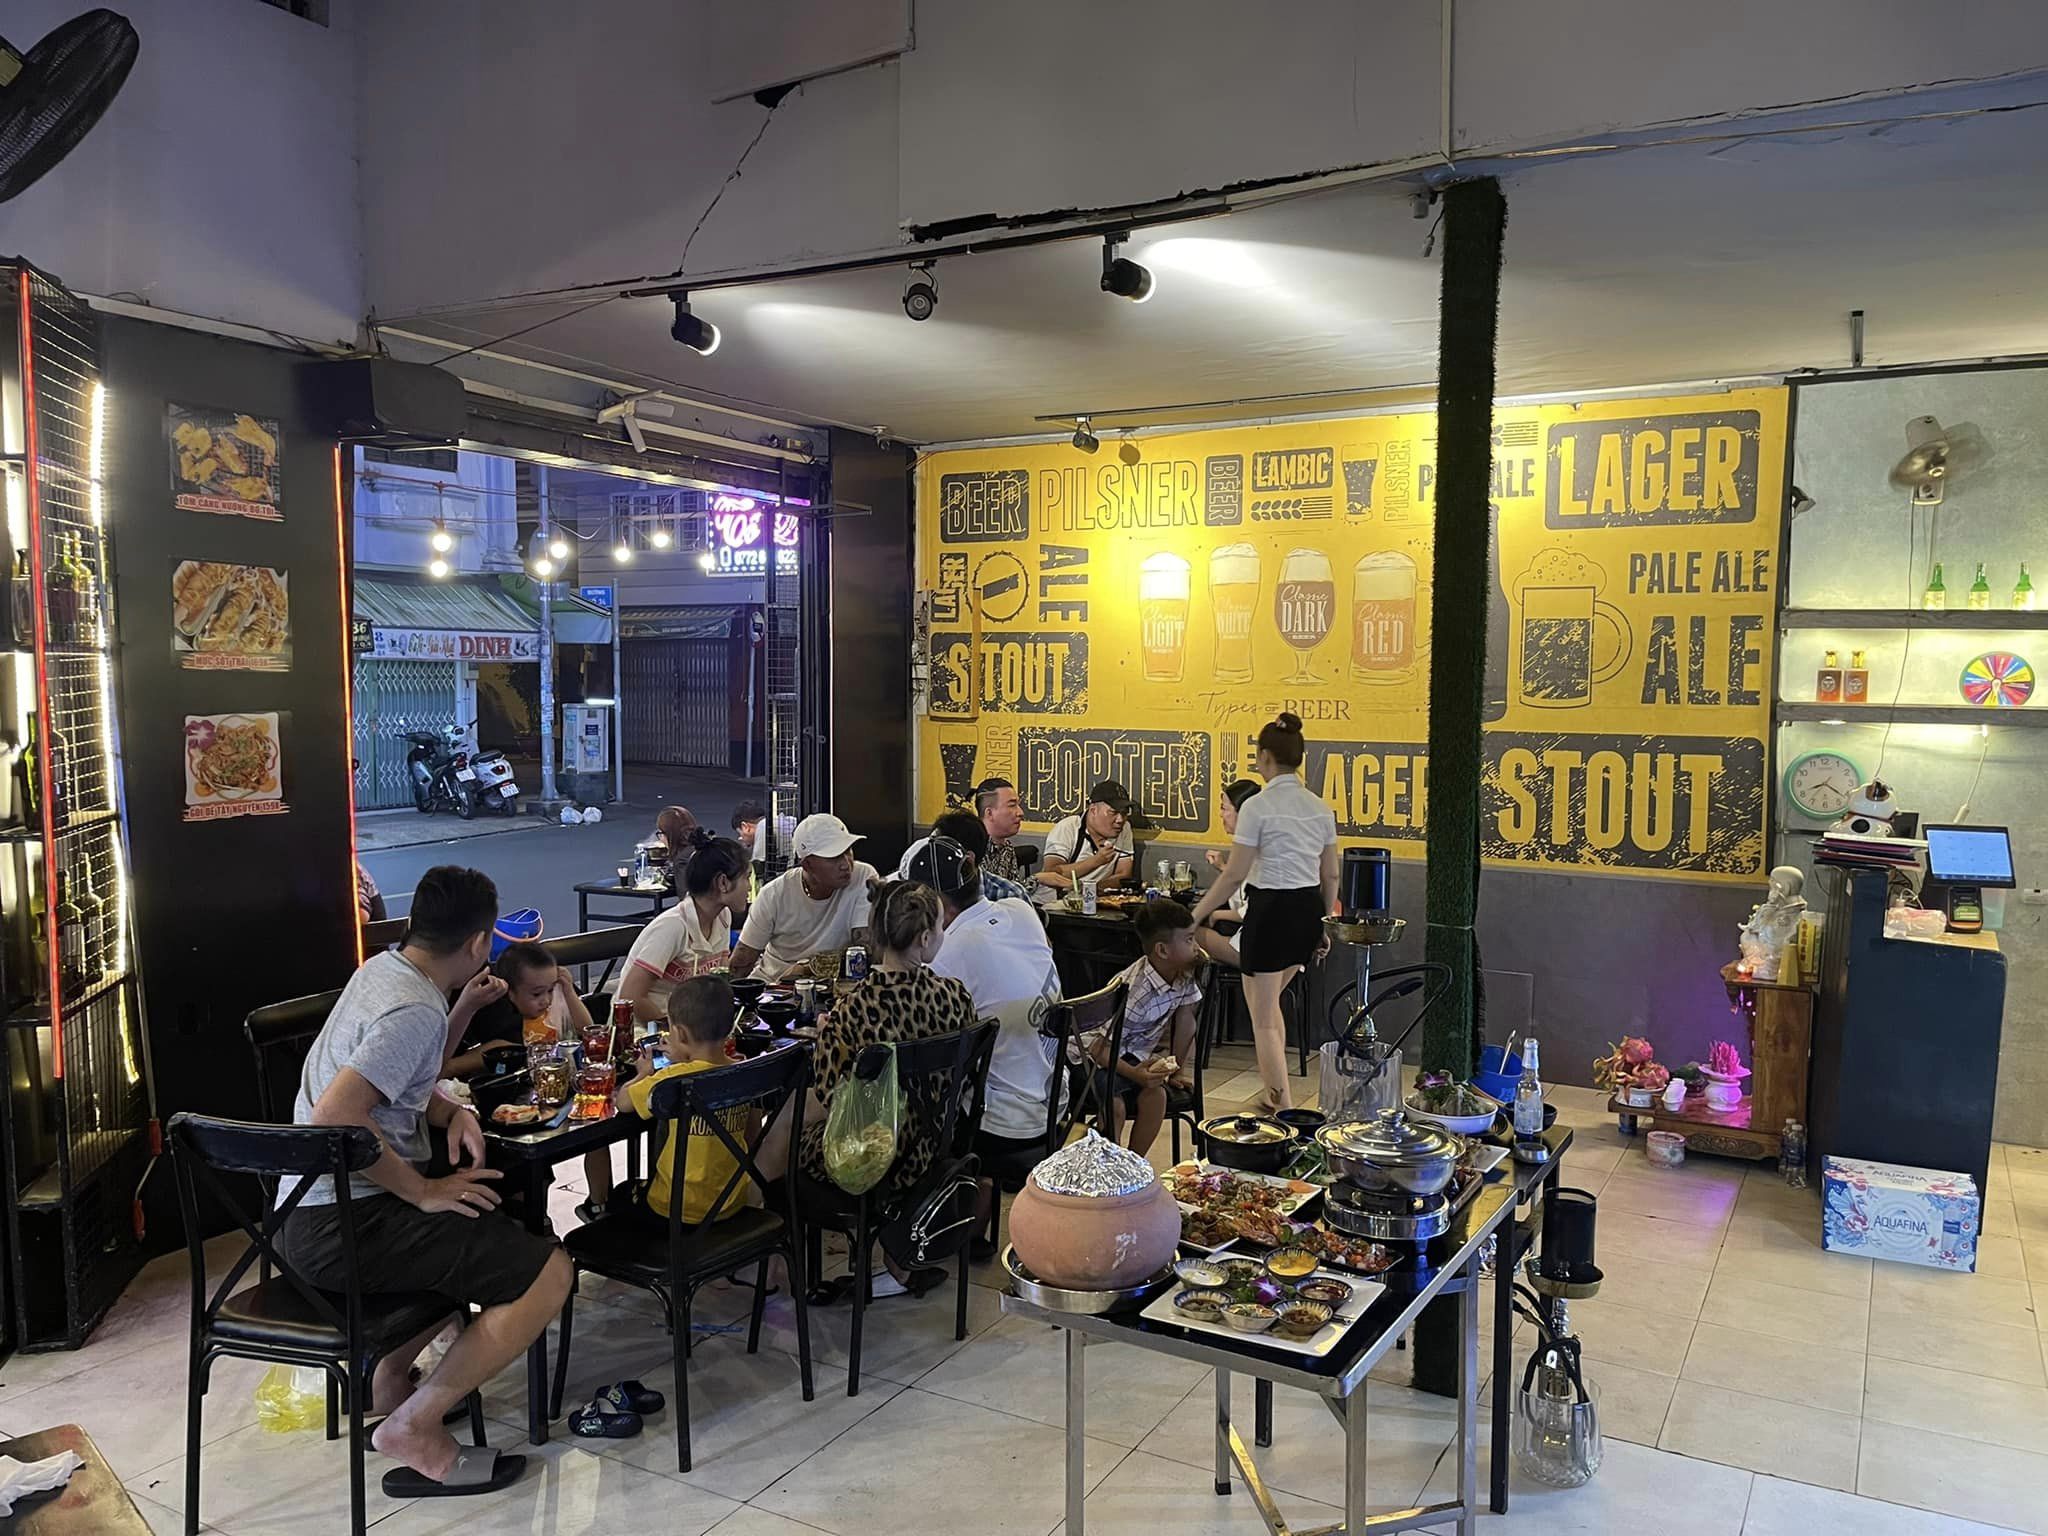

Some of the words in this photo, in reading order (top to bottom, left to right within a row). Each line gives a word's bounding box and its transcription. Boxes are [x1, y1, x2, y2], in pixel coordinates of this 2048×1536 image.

[1040, 459, 1198, 532] PILSNER
[1208, 460, 1240, 521] BEER
[1256, 452, 1332, 488] LAMBIC
[1384, 440, 1411, 521] PILSNER
[1558, 426, 1742, 515] LAGER
[947, 480, 1023, 535] BEER
[1039, 544, 1089, 623] ALE
[1281, 584, 1329, 601] Classic
[1629, 552, 1702, 594] PALE
[1712, 550, 1770, 592] ALE
[1143, 620, 1184, 648] LIGHT
[1281, 600, 1327, 632] DARK
[1362, 620, 1404, 654] RED
[948, 642, 1070, 704] STOUT
[1640, 615, 1764, 706] ALE
[1198, 690, 1258, 729] Types
[1283, 699, 1352, 721] BEER
[1028, 739, 1200, 820] PORTER
[1303, 751, 1428, 828] AGER
[1498, 748, 1724, 855] STOUT
[1873, 1215, 1928, 1235] AQUAFINA
